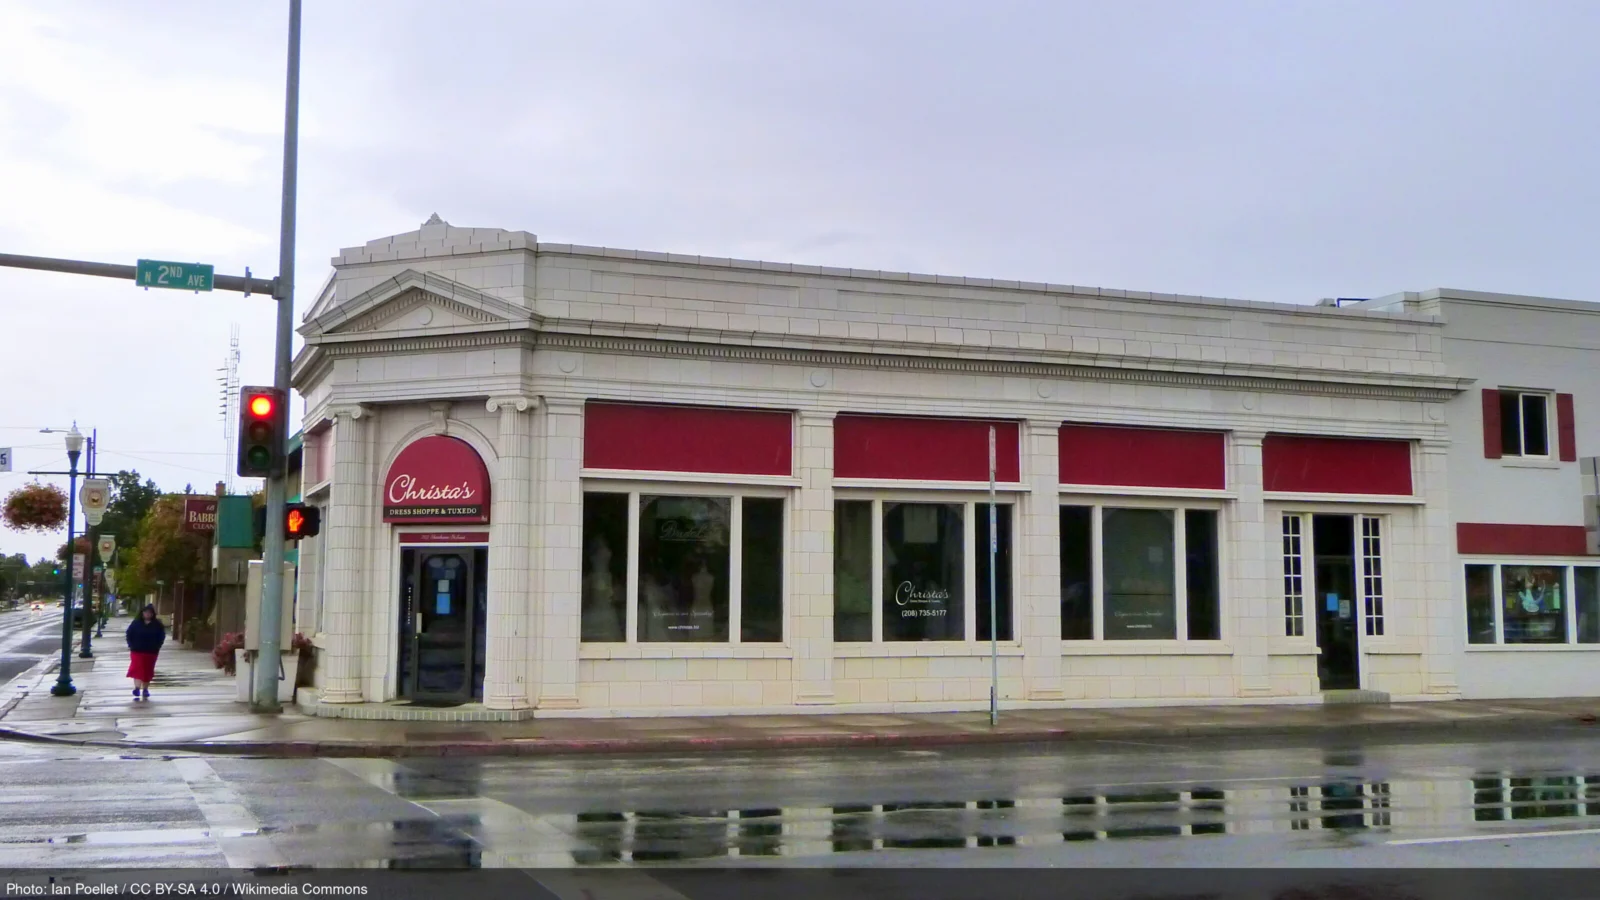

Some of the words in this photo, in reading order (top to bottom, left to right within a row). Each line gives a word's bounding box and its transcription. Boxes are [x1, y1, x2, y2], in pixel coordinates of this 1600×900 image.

[145, 271, 152, 283] N
[157, 265, 183, 284] 2ND
[187, 274, 205, 287] AVE
[389, 474, 475, 503] Christa's
[447, 507, 477, 515] TUXEDO
[895, 580, 949, 606] Christa's
[901, 609, 918, 618] (208)
[918, 609, 947, 617] 735-5177
